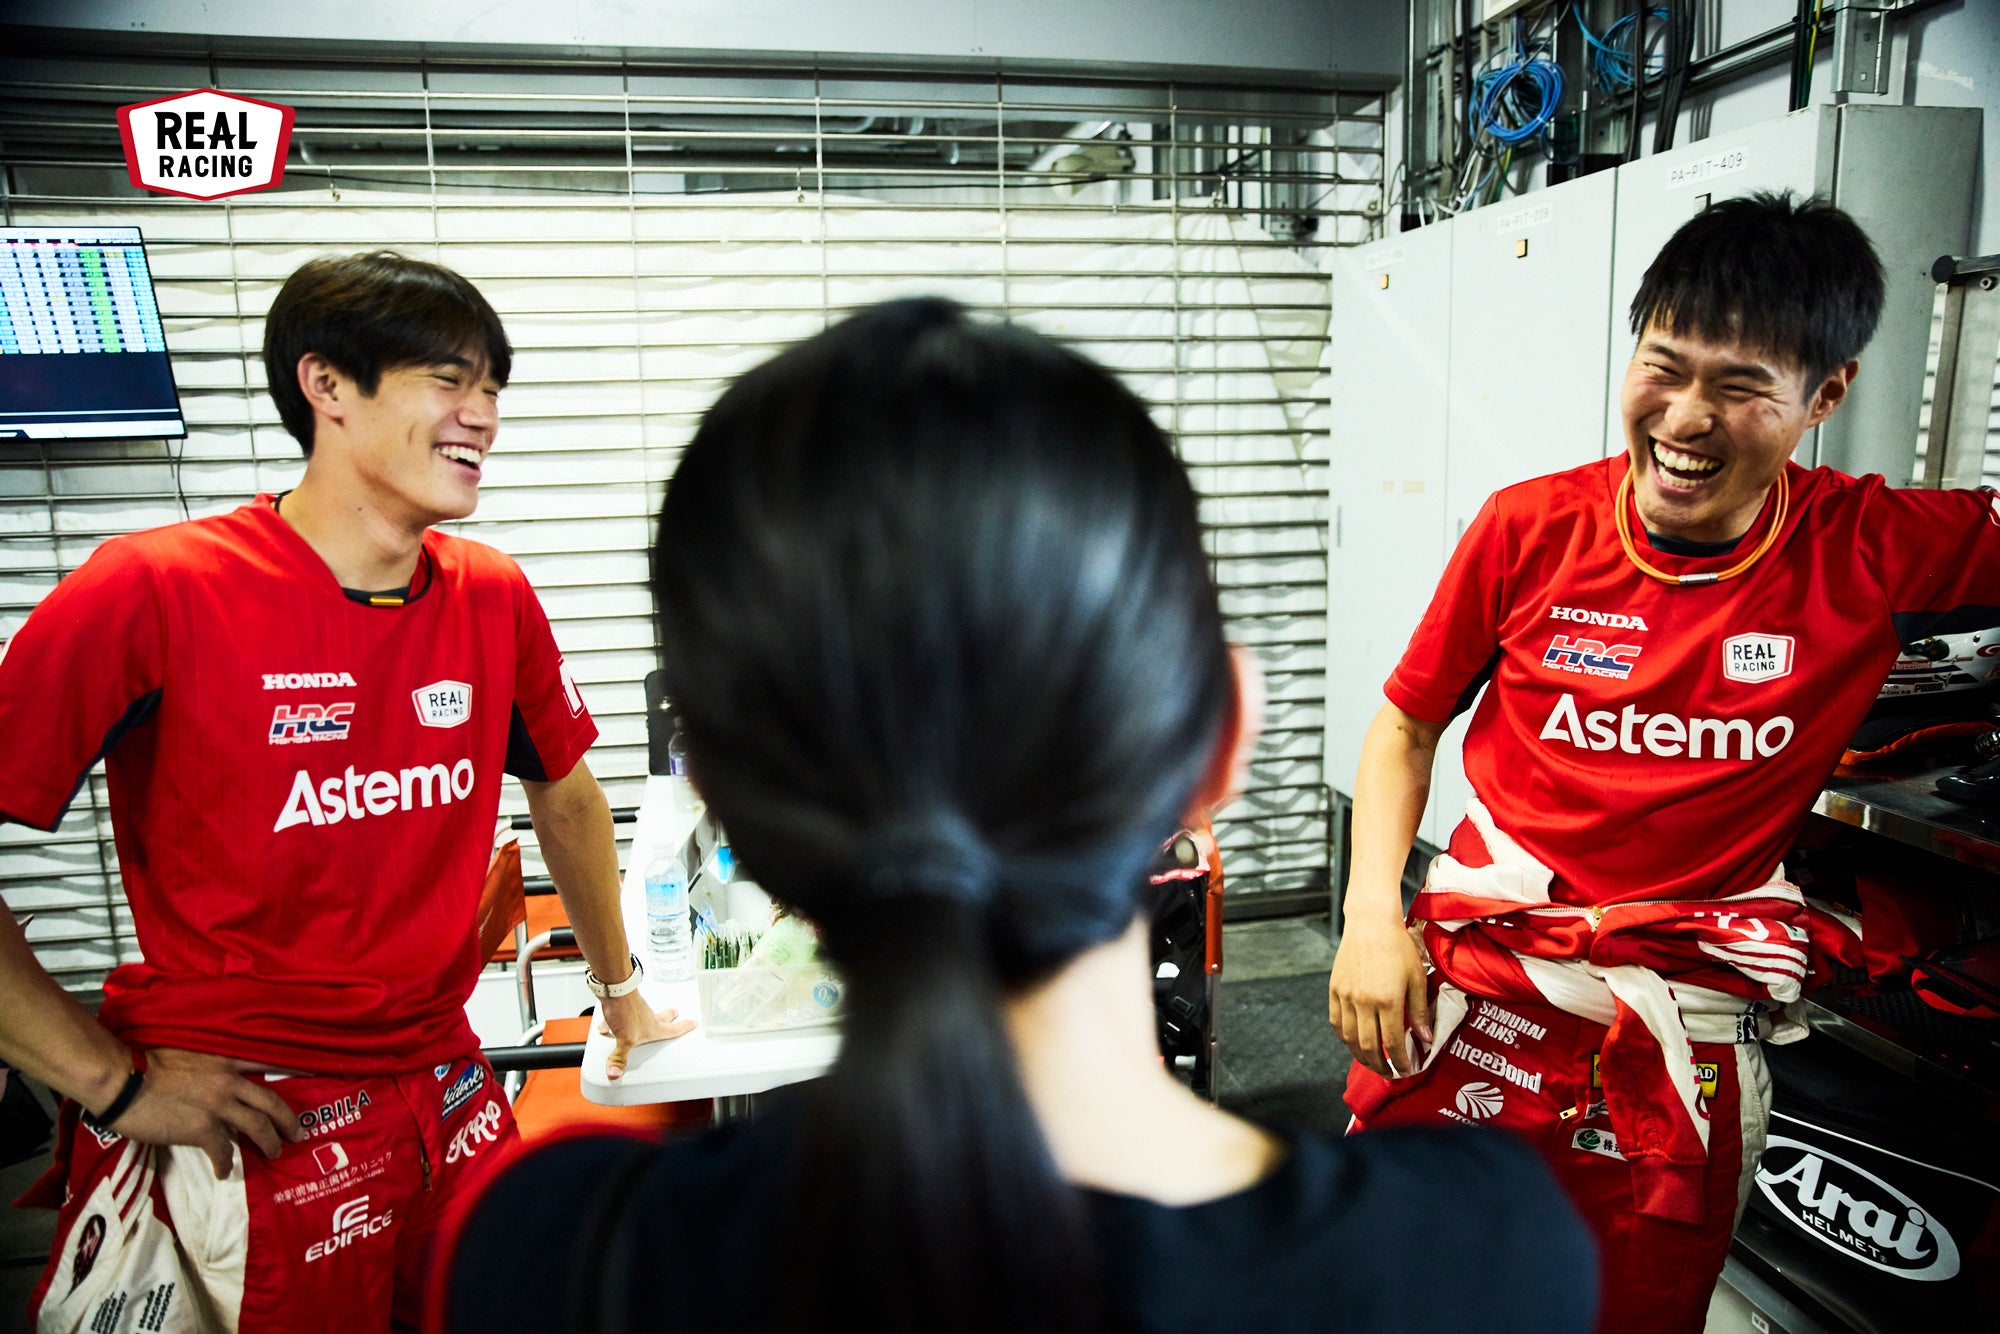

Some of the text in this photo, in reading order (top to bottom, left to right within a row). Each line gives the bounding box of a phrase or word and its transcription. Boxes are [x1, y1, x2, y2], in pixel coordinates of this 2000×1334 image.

[1671, 153, 1744, 184] PA-PIT-409
[1549, 606, 1648, 631] HONDA
[1541, 661, 1629, 680] Honda RACING
[1543, 634, 1643, 674] HRC
[1732, 643, 1776, 661] REAL
[1734, 659, 1775, 672] RACING
[261, 672, 357, 690] HONDA
[428, 690, 464, 708] REAL
[269, 702, 355, 738] HRC
[432, 706, 464, 719] RACING
[1539, 693, 1795, 761] Astemo
[273, 758, 475, 833] Astemo
[1469, 1015, 1518, 1045] JEANS
[1479, 1000, 1547, 1041] SAMURAI
[1450, 1034, 1542, 1095] hreeBond
[299, 1090, 372, 1129] OBILA
[445, 1100, 502, 1164] KRP
[1756, 1153, 1932, 1261] Arai
[305, 1208, 393, 1263] EDIFICE
[1803, 1210, 1881, 1258] HELMET
